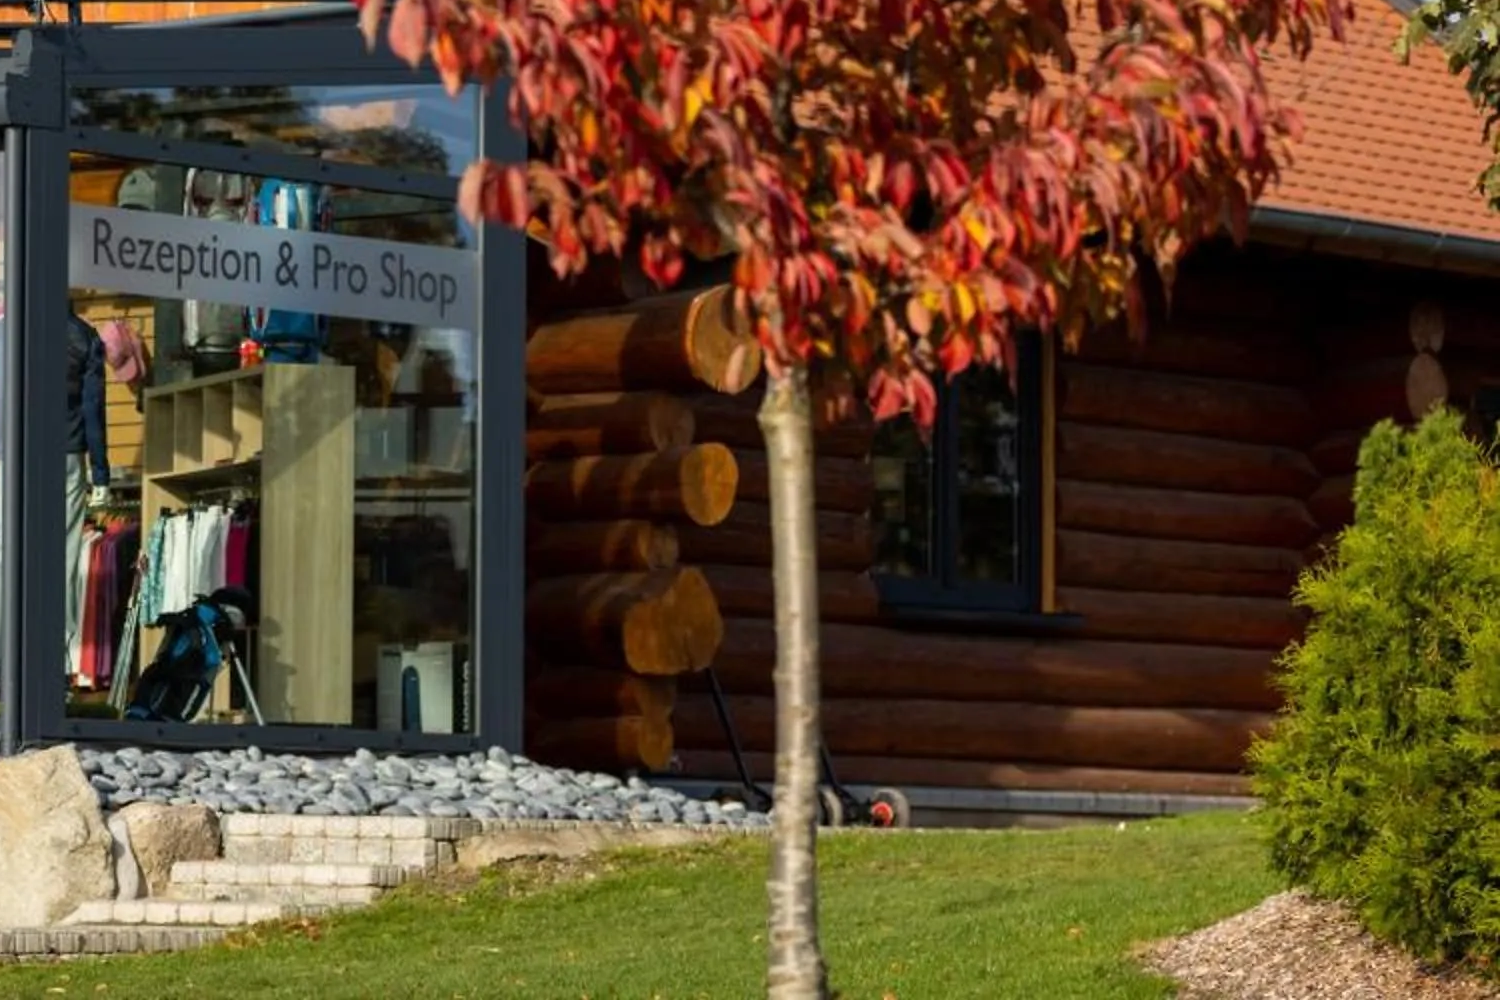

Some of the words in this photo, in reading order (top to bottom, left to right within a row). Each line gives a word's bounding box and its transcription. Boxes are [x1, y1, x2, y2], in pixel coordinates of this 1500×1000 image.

[93, 218, 261, 290] Rezeption
[275, 241, 298, 288] &
[312, 244, 367, 295] Pro
[380, 251, 457, 319] Shop
